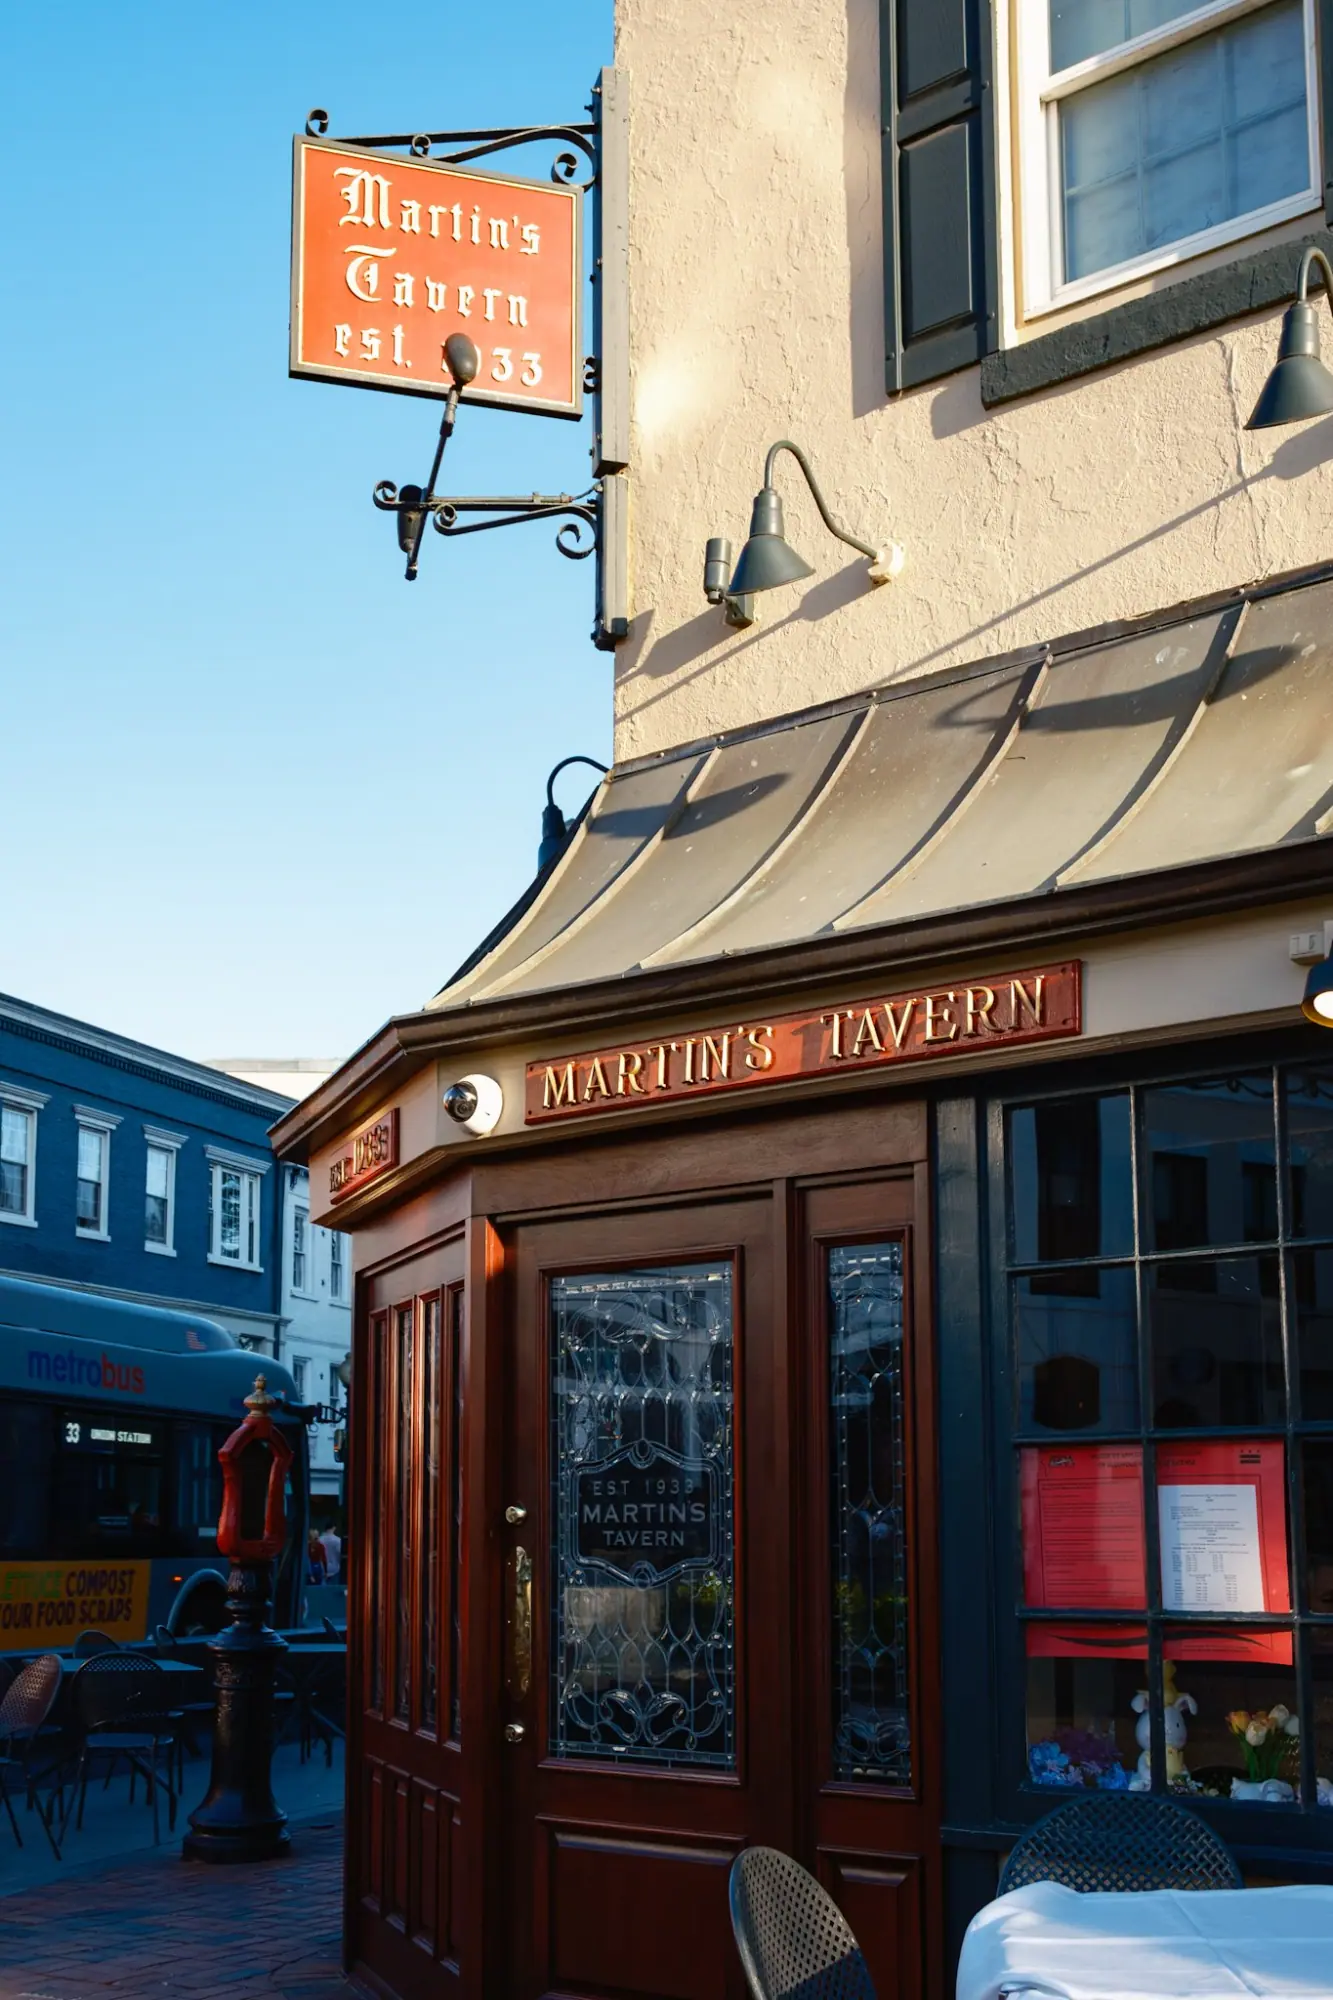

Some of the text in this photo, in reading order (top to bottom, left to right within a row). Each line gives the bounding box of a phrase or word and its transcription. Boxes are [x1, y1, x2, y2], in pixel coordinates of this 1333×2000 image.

[333, 166, 541, 256] Martin's
[343, 244, 529, 329] Tavern
[334, 322, 543, 388] est. 33
[541, 974, 1046, 1109] MARTIN'S TAVERN
[27, 1349, 146, 1394] metrobus
[65, 1422, 81, 1444] 33
[592, 1479, 695, 1496] EST 1933
[603, 1530, 685, 1547] TAVERN
[0, 1568, 136, 1601] ETTUCE COMPOST
[0, 1597, 133, 1630] OUR FOOD SCRAPS
